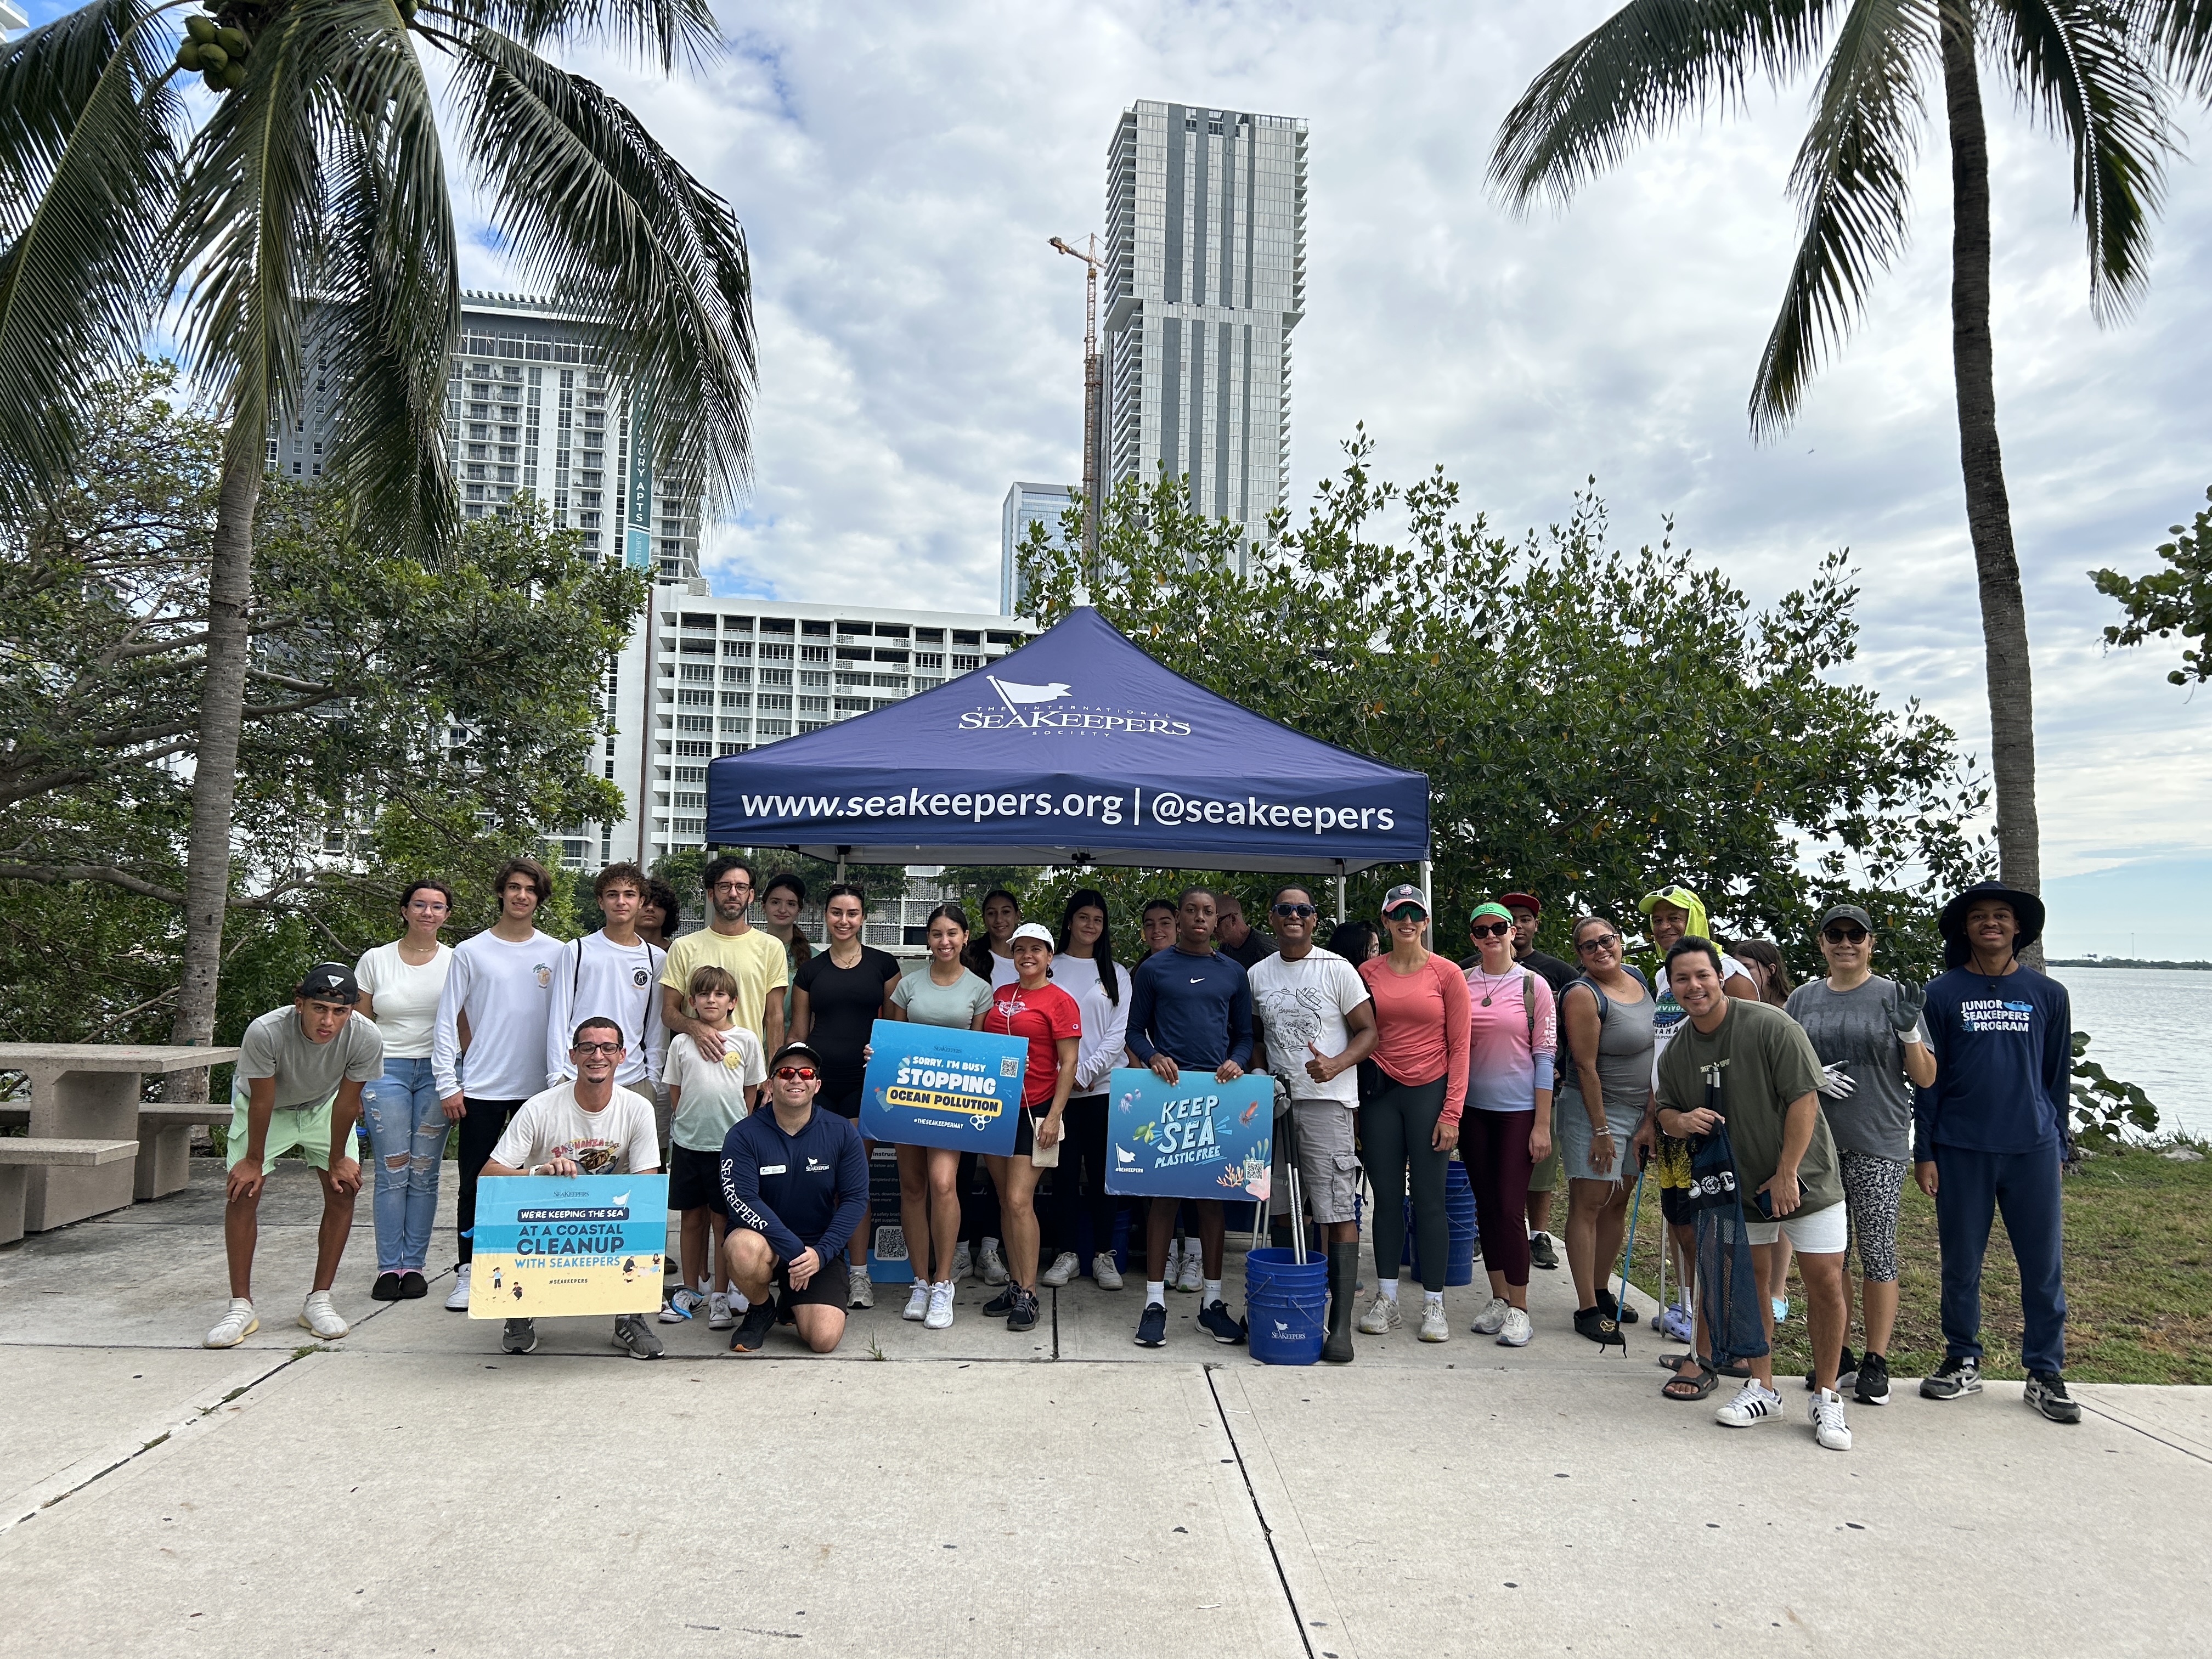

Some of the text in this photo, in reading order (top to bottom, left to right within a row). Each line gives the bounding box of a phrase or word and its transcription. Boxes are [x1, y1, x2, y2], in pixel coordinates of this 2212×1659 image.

[635, 481, 645, 522] APTS
[1024, 705, 1171, 718] INTERNATIONAL
[958, 710, 1192, 736] SEAKEEPERS
[741, 787, 1124, 825] www.seakeepers.org
[1152, 792, 1395, 834] @seakeepers
[1961, 999, 2003, 1013] JUNIOR
[1962, 1010, 2030, 1022] SEAKEEPERS
[1973, 1021, 2029, 1032] PROGRAM
[912, 1056, 986, 1073] SORRY, I'M BUSY
[896, 1068, 996, 1096] STOPPING
[890, 1089, 998, 1112] OCEAN POLLUTION
[1161, 1095, 1218, 1124] KEEP
[1157, 1115, 1215, 1154] SEA
[1154, 1145, 1221, 1169] PLASTIC FREE
[721, 1158, 769, 1230] SEAKEEPERS
[521, 1209, 624, 1219] WE'RE KEEPING THE SEA
[519, 1223, 623, 1237] AT A COASTAL
[517, 1237, 624, 1256] CLEANUP
[515, 1256, 620, 1269] WITH SEAKEEPERS
